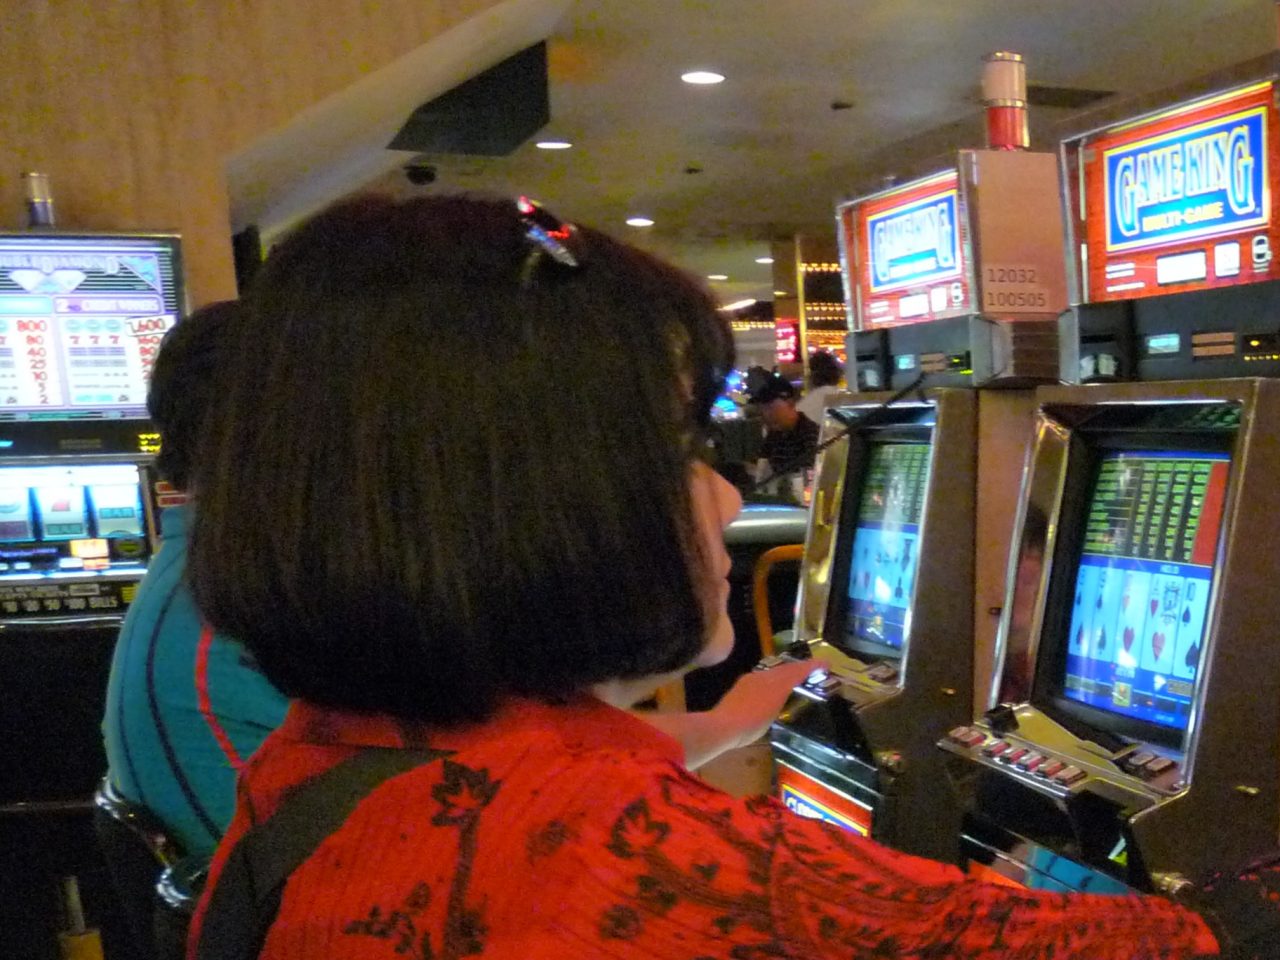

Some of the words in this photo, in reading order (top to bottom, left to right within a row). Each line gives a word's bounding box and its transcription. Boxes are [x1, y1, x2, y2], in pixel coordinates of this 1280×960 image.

[1115, 143, 1184, 237] GAME
[1185, 125, 1255, 215] KING
[988, 268, 1036, 284] 12032
[988, 292, 1046, 307] 100505
